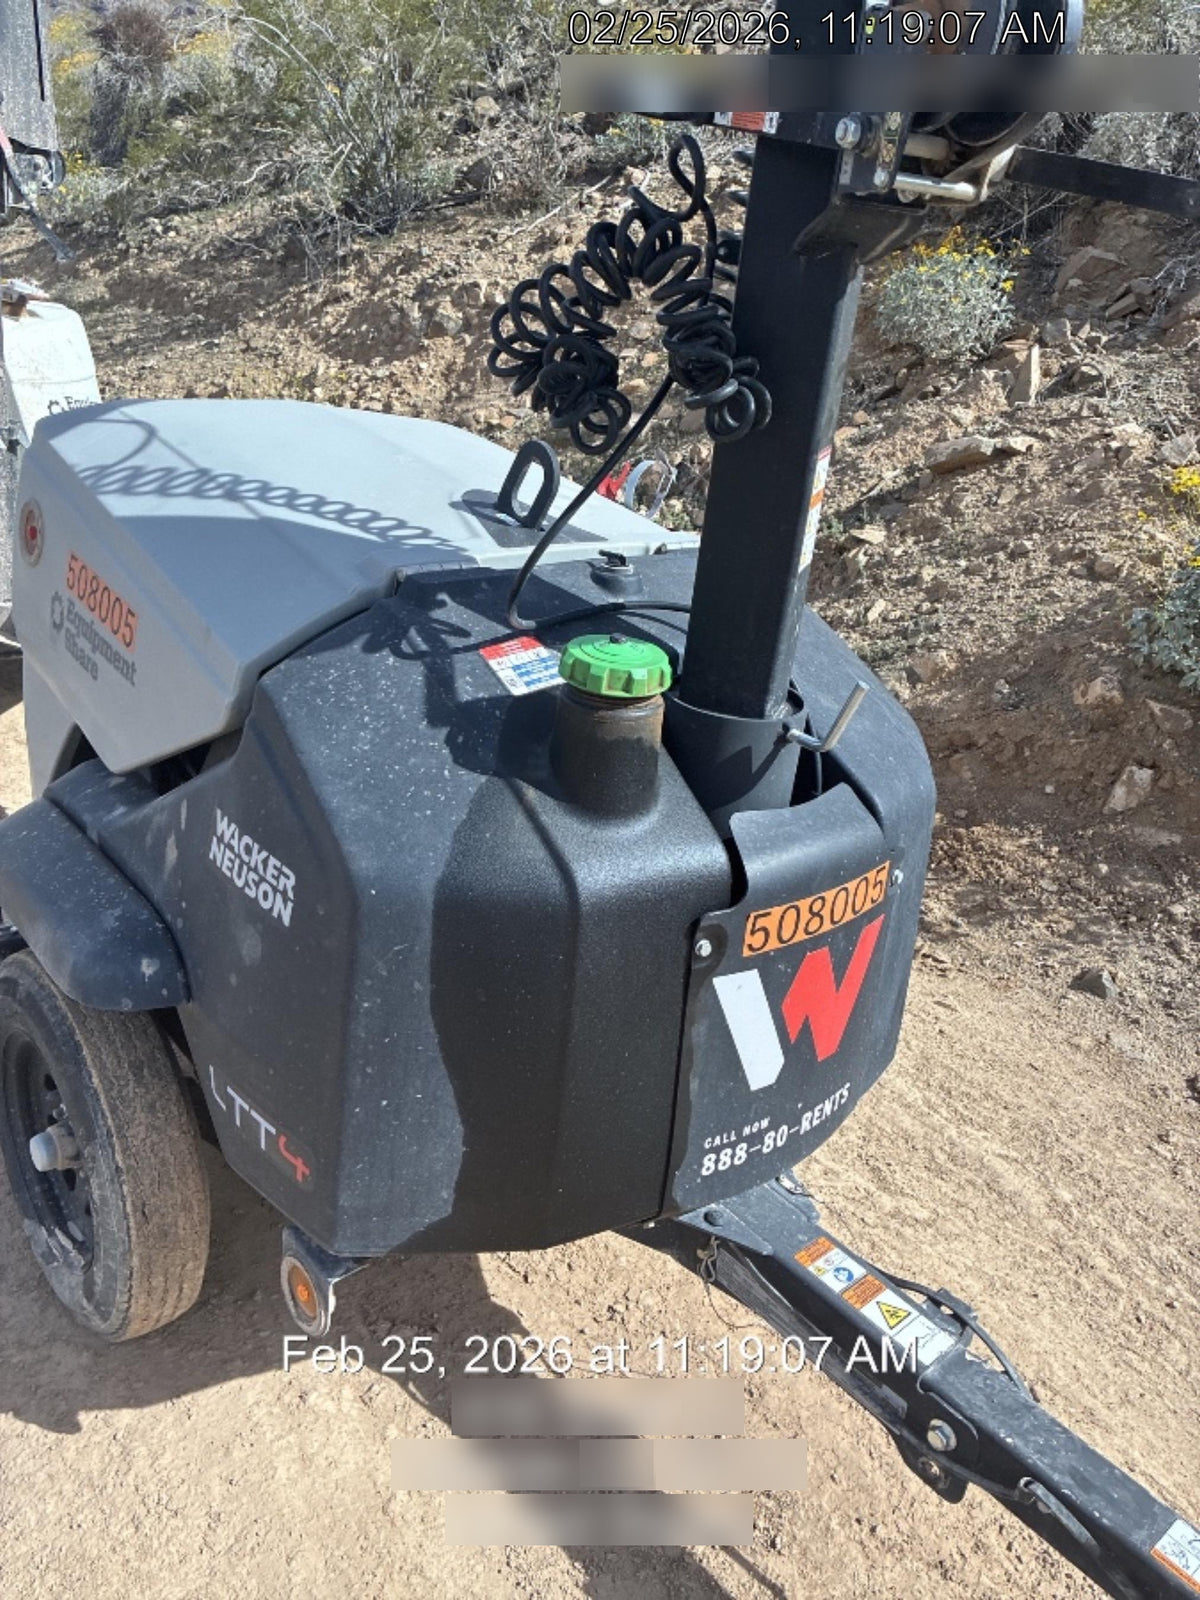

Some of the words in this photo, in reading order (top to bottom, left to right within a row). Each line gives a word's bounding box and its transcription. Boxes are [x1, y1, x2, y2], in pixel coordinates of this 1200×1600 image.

[66, 552, 136, 648] 508005
[66, 598, 138, 687] Equipment
[64, 627, 99, 681] Share
[208, 835, 295, 928] NEUSON
[215, 807, 296, 900] WACKER
[746, 864, 889, 954] 508005
[208, 1064, 310, 1183] LTT4
[700, 1081, 851, 1176] 888-80-RENTS
[704, 1130, 737, 1150] CALL
[742, 1116, 771, 1138] NOW
